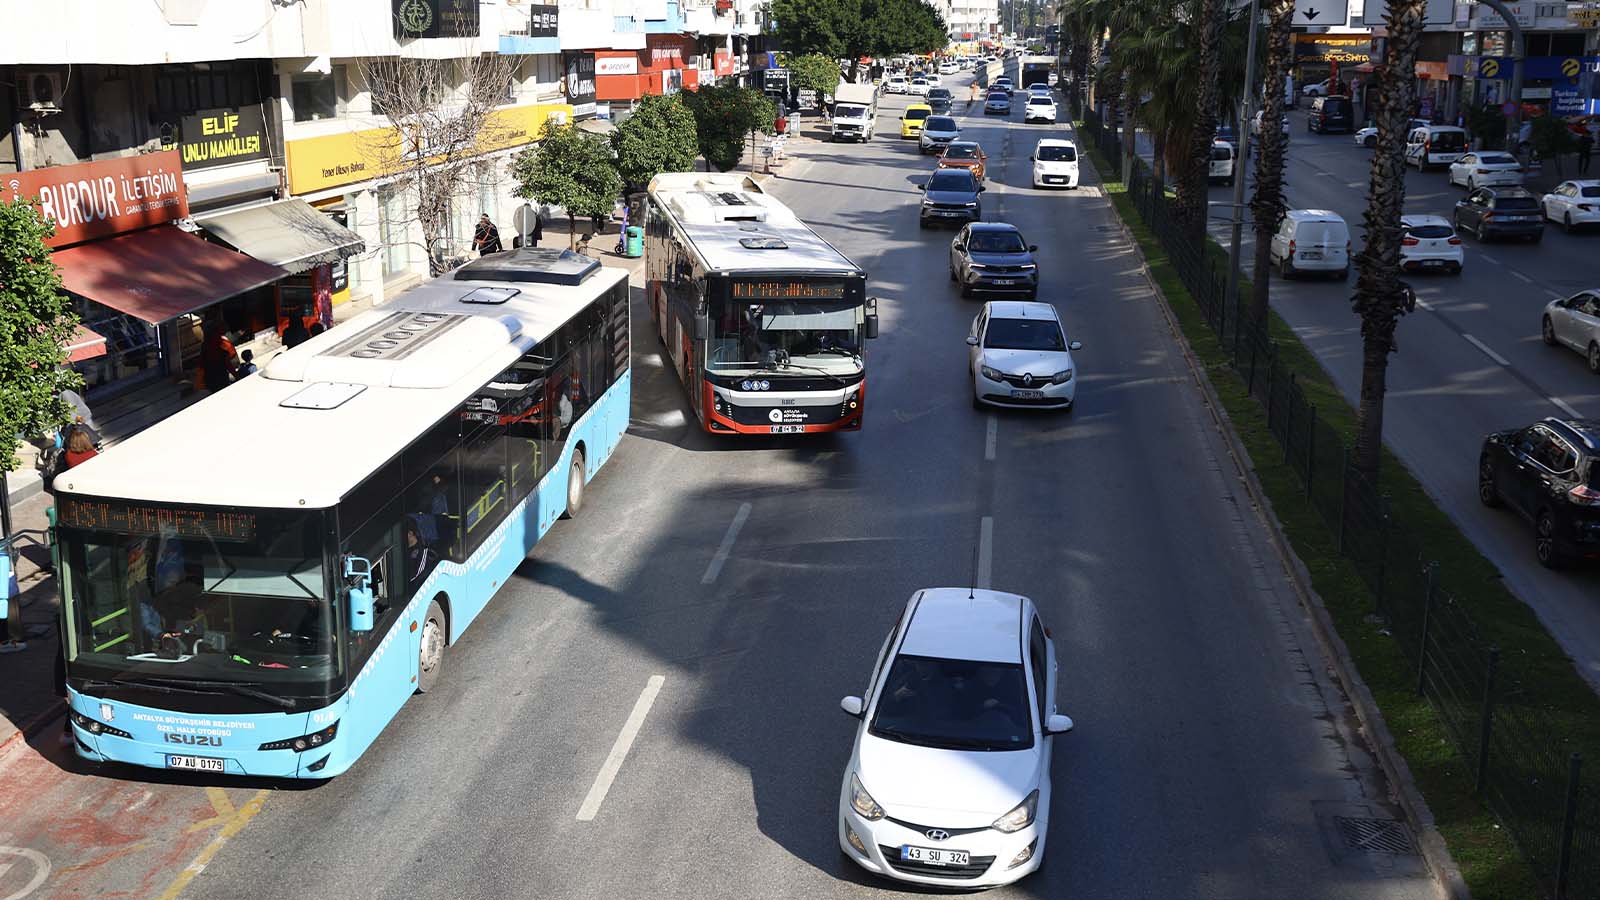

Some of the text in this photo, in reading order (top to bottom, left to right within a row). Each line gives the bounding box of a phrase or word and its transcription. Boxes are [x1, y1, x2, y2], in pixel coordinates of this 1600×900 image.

[201, 111, 239, 136] ELİF
[182, 130, 260, 163] UNLU MAMÜLLERİ
[39, 168, 178, 230] BURDUR İLETİŞİM
[132, 713, 164, 723] ANTALYA
[176, 727, 196, 735] HALK
[164, 732, 223, 747] ISUZU
[171, 756, 222, 770] 07 AU 0179
[908, 849, 921, 859] 43
[928, 851, 941, 861] SU
[949, 852, 968, 864] 324
